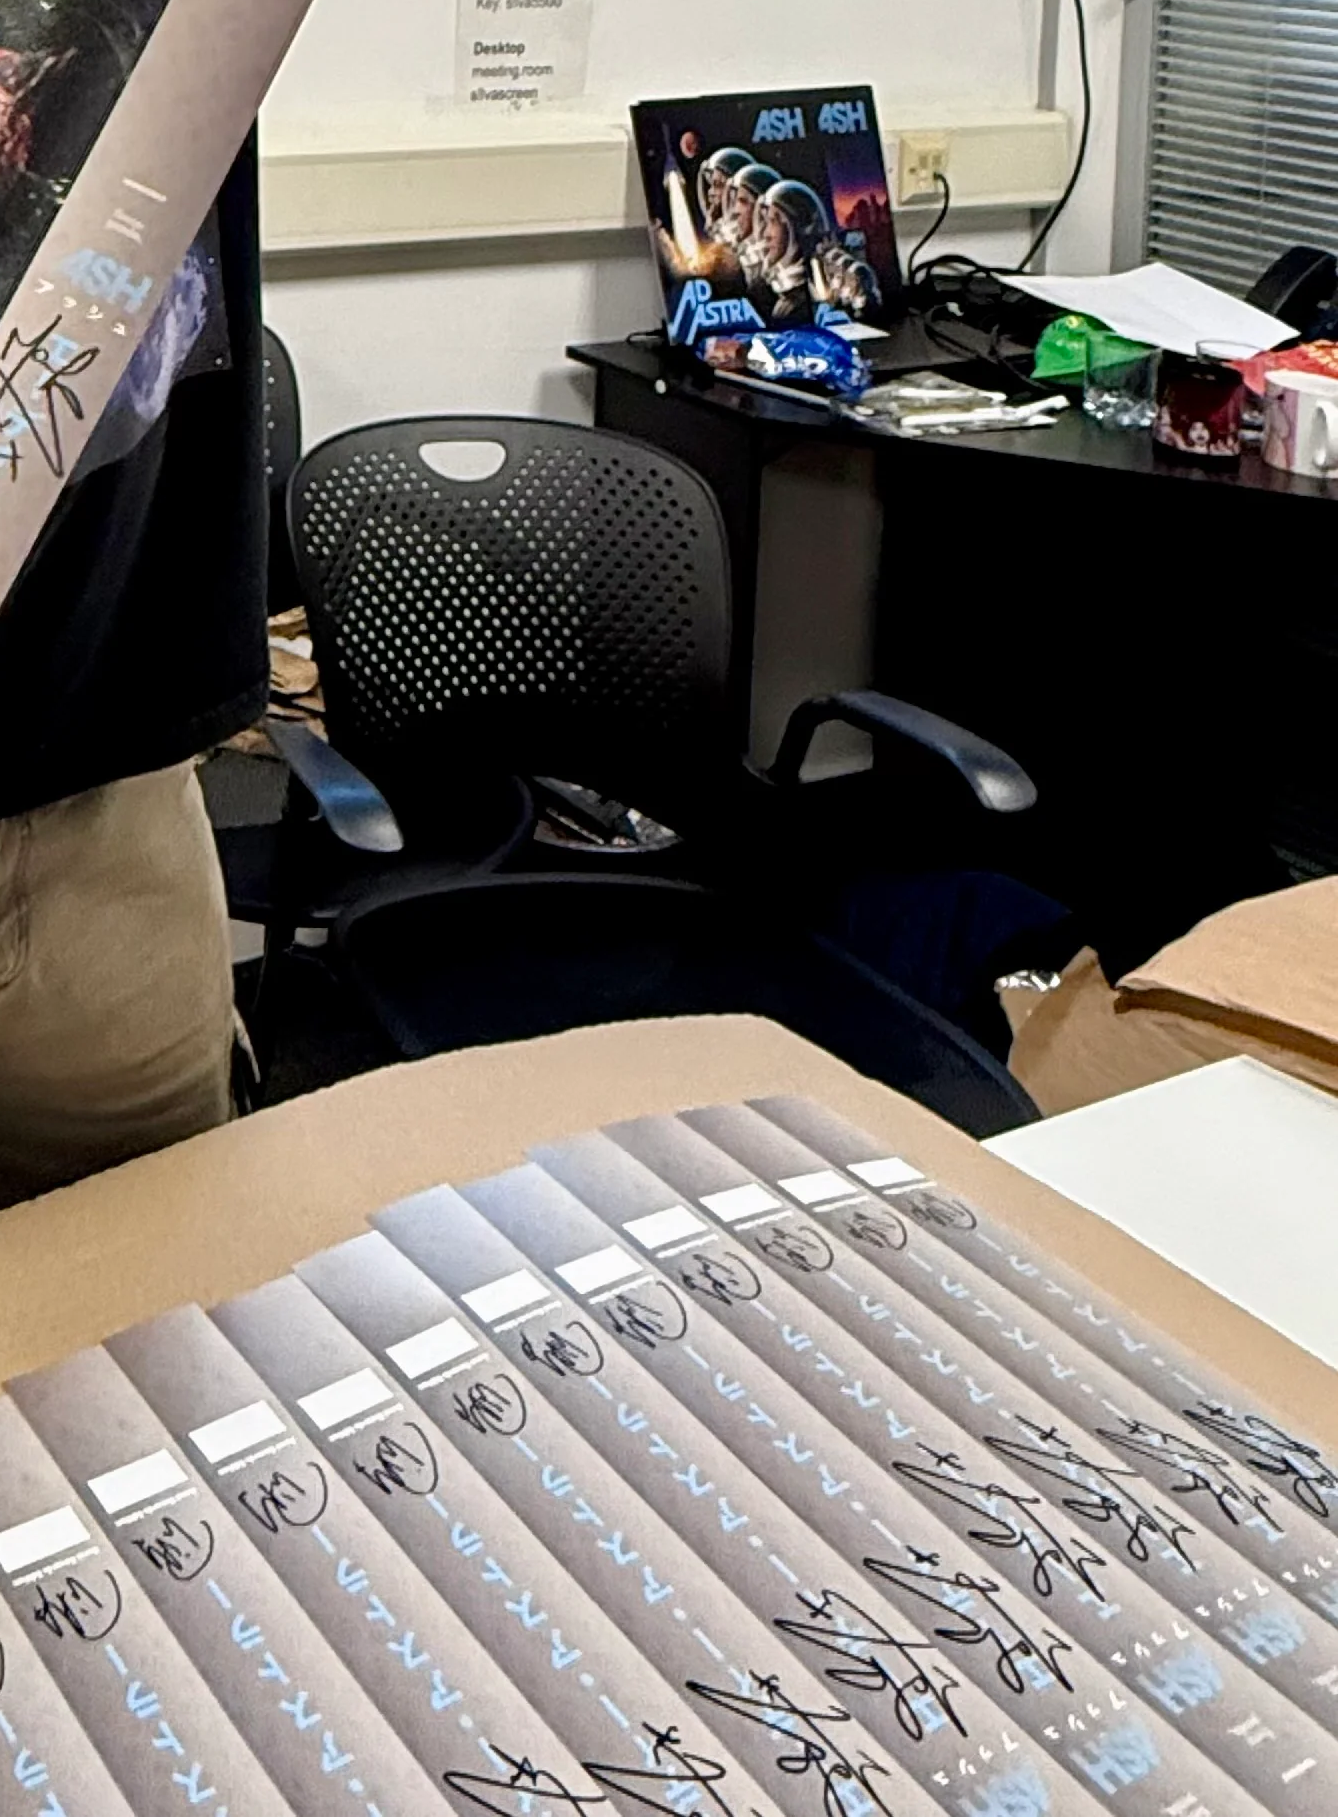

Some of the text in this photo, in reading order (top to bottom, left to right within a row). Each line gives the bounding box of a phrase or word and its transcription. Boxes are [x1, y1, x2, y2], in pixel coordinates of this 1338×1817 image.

[473, 41, 525, 58] Desktop
[752, 106, 806, 143] ASH
[818, 100, 868, 134] ASH
[57, 247, 153, 315] ASH
[668, 279, 712, 346] AD
[685, 297, 767, 346] ASTRA
